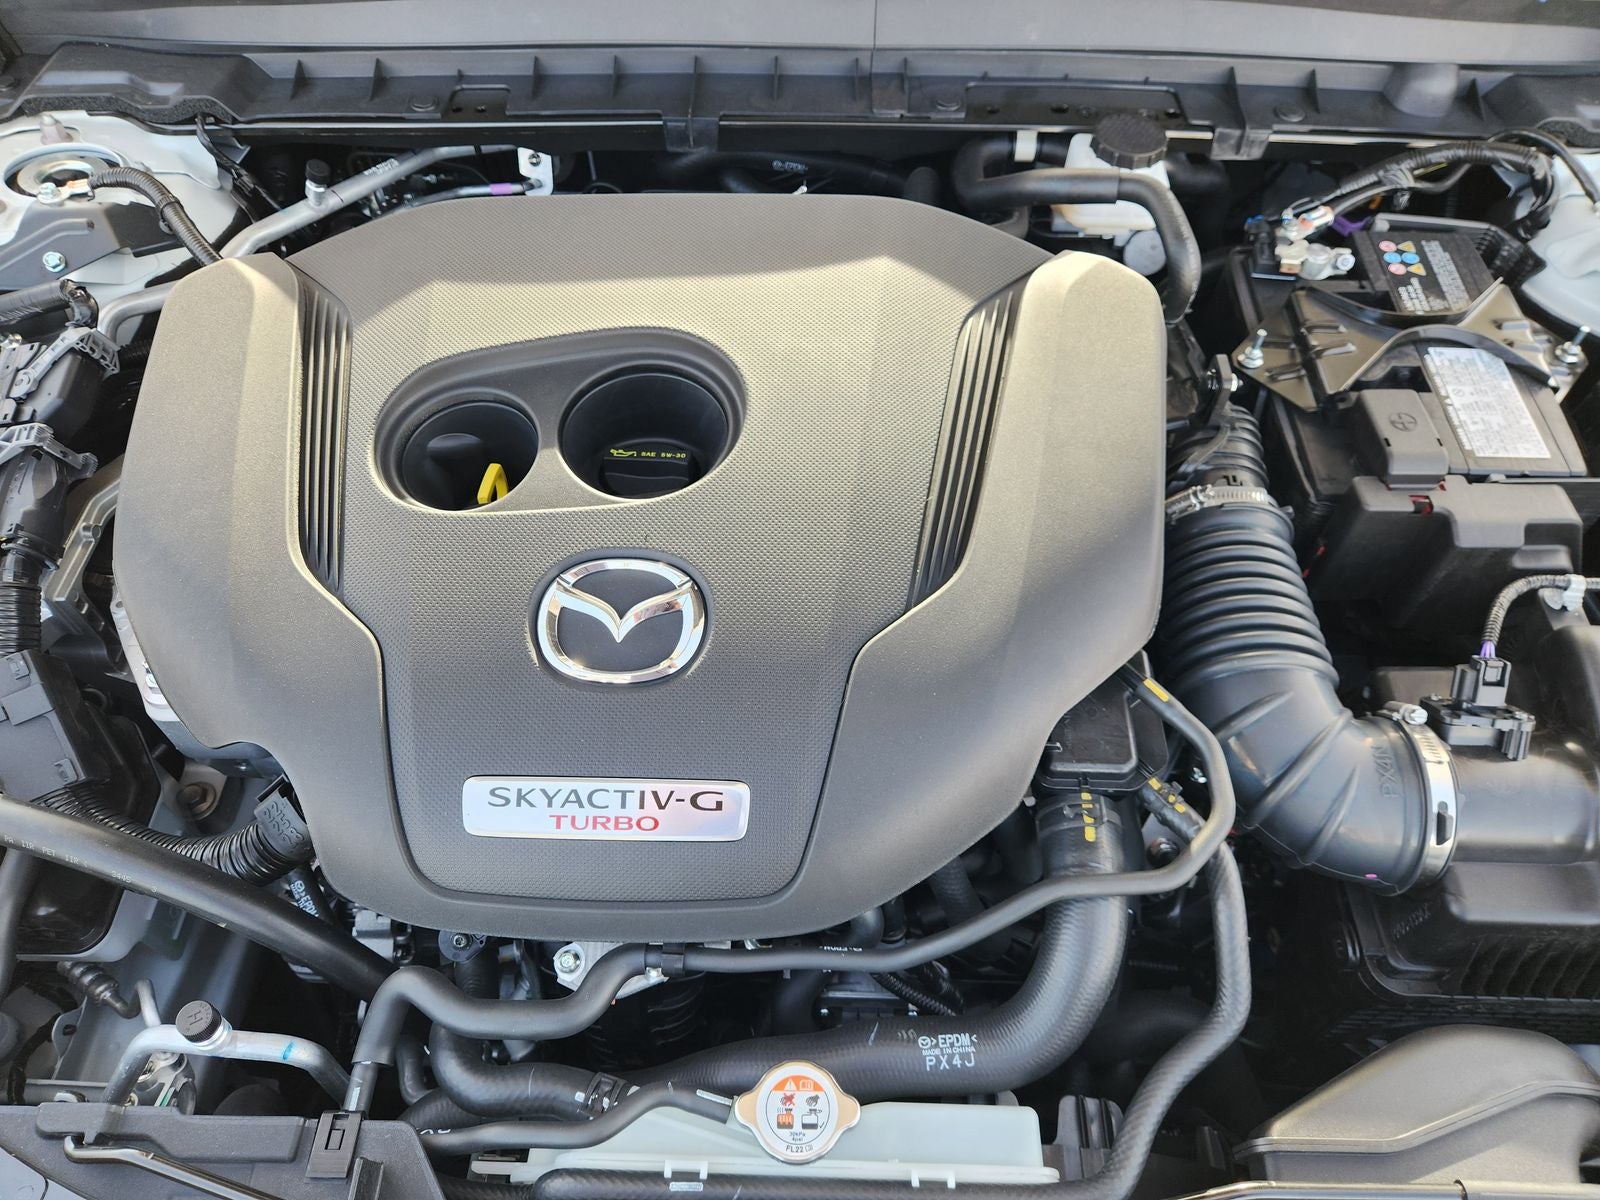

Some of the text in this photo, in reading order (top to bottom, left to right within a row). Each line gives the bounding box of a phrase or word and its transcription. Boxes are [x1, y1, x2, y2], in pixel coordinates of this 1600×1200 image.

[488, 787, 724, 811] SKYACTIV-G
[549, 815, 660, 831] TURBO
[785, 1145, 804, 1153] FL22
